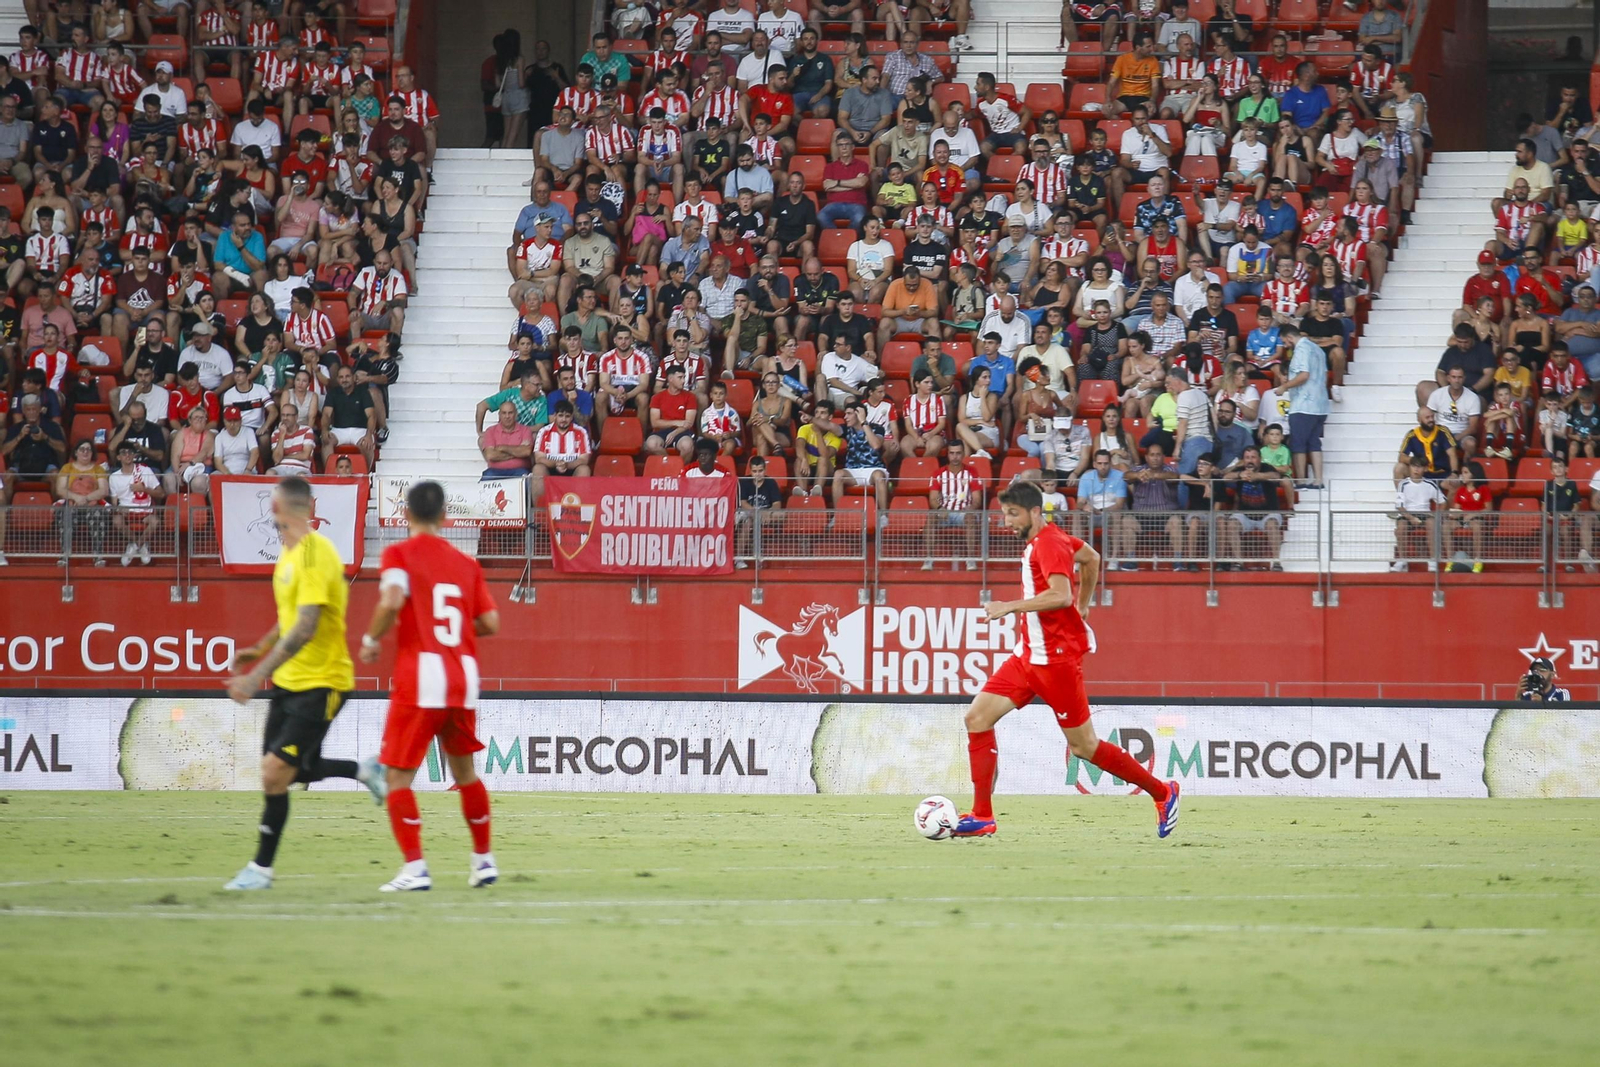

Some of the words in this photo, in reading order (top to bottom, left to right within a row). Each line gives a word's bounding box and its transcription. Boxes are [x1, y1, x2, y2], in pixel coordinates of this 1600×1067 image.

[650, 476, 679, 491] PEÑA
[384, 518, 394, 526] EL
[453, 518, 478, 527] ANGEL
[600, 494, 729, 529] SENTIMIENTO
[601, 532, 727, 568] ROJIBLANCO
[432, 583, 464, 647] 5
[872, 605, 1017, 650] POWER
[80, 622, 235, 672] Costa
[484, 735, 769, 776] MERCOPHAL
[1166, 740, 1441, 780] MERCOPHAL
